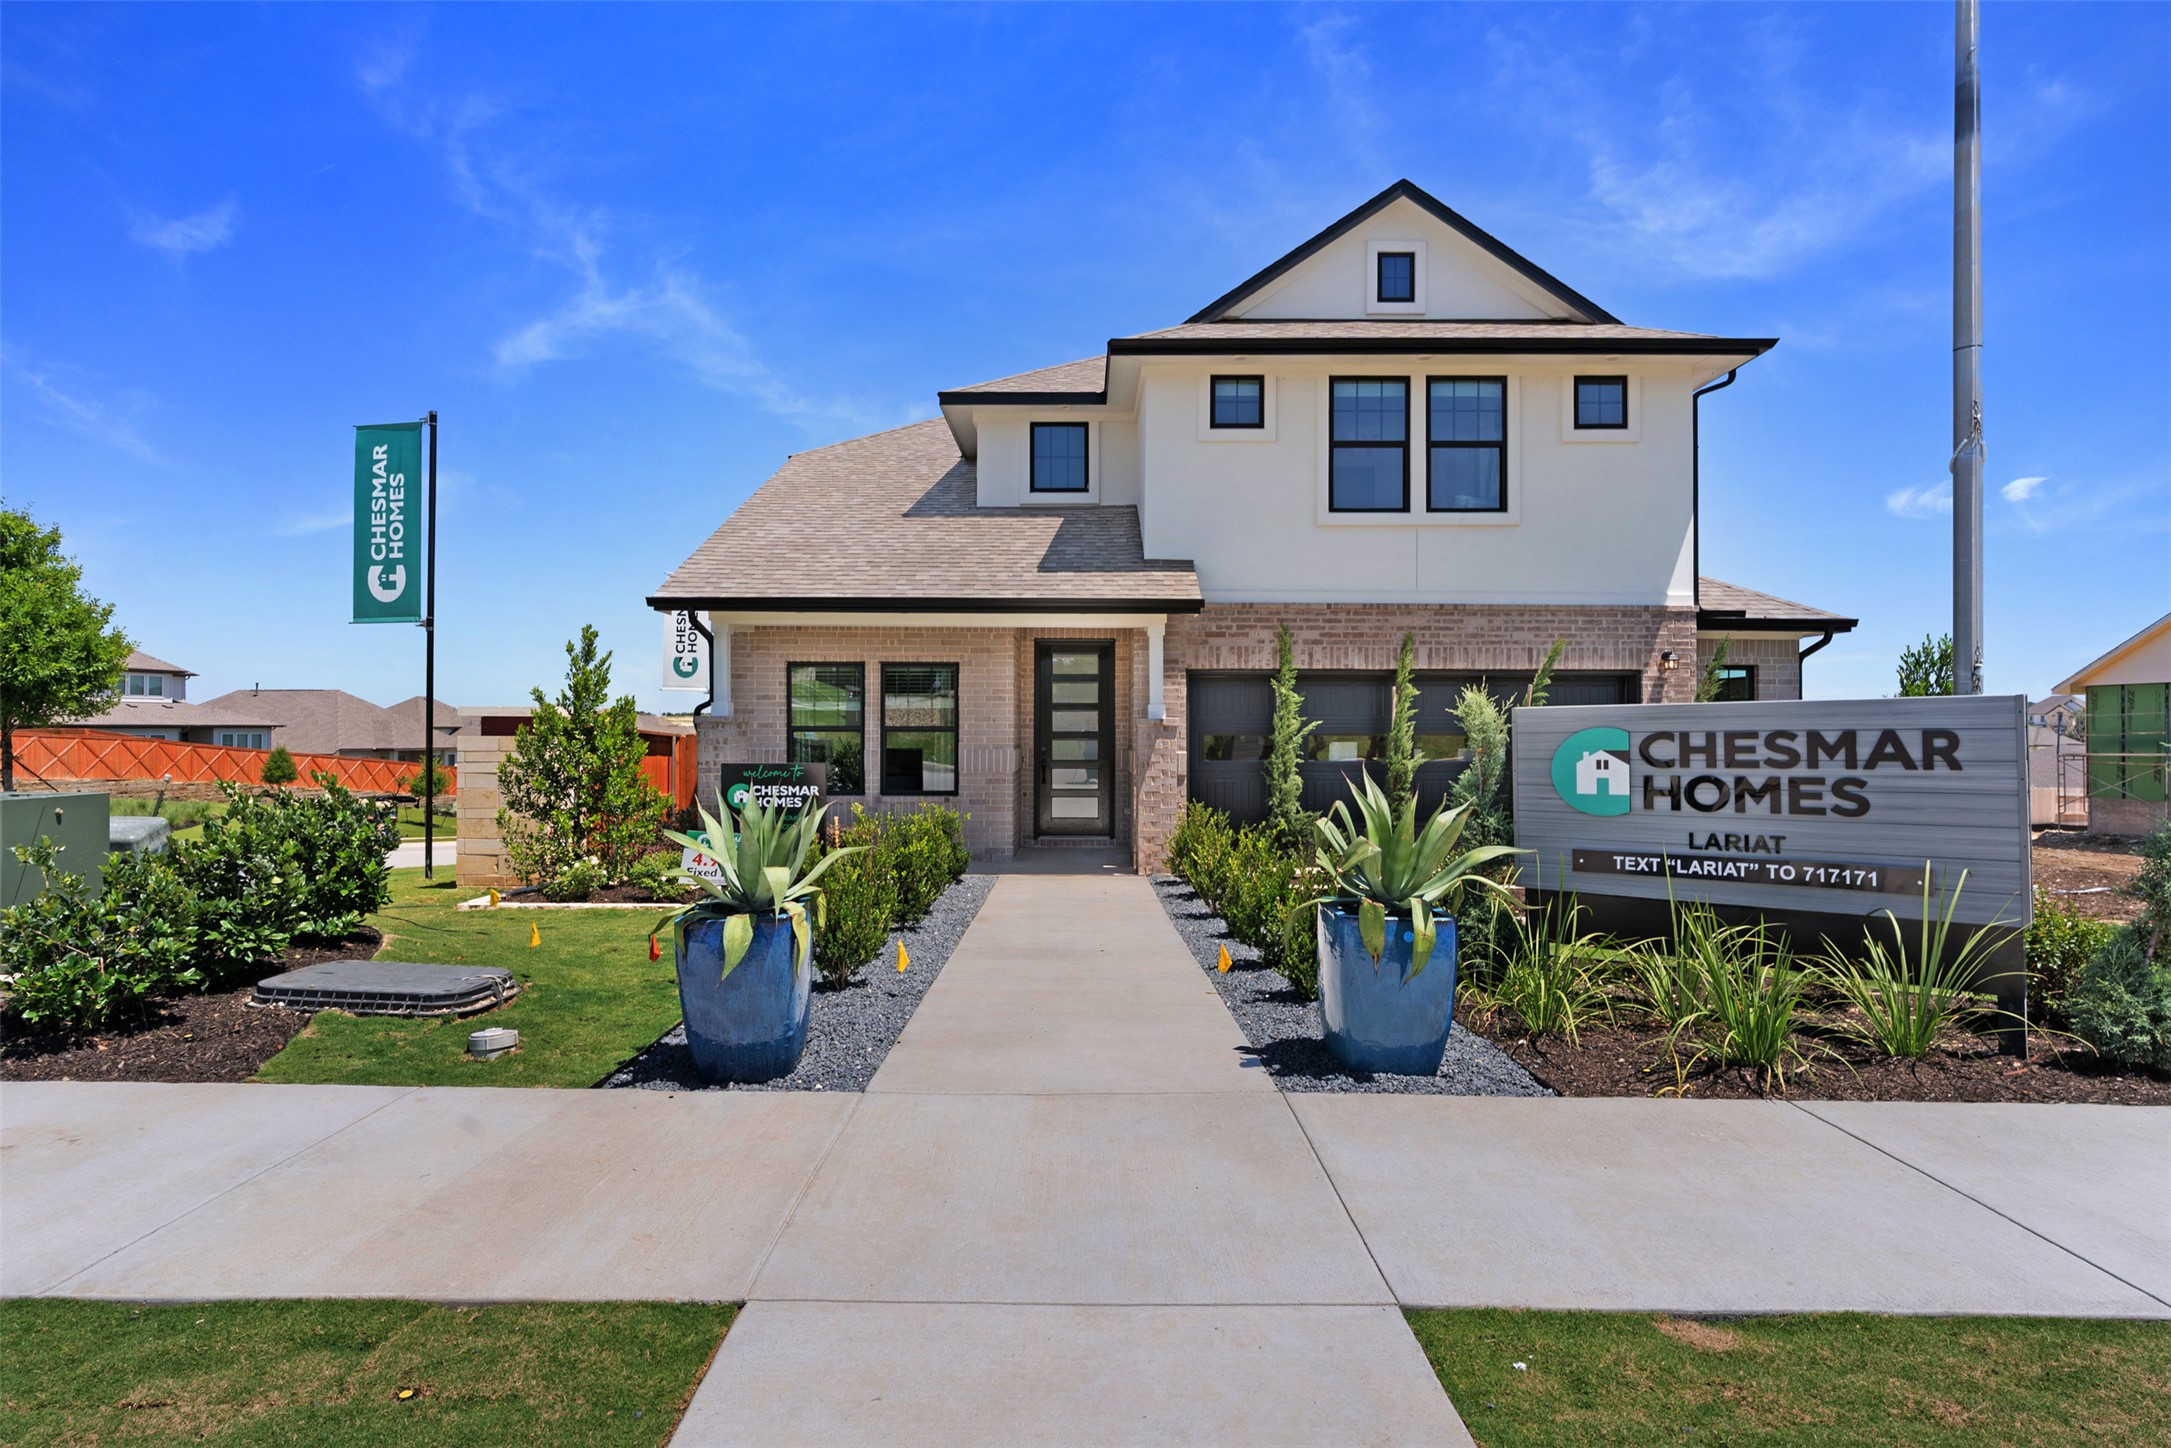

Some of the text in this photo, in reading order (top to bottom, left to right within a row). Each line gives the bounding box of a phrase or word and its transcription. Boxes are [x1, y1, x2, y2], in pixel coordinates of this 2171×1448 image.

[371, 444, 388, 561] CHESMAR
[388, 473, 405, 559] HOMES
[1639, 730, 1963, 771] CHESMAR
[743, 764, 804, 782] welcome to
[752, 785, 820, 796] CHESMAR
[1643, 775, 1871, 817] HOMES
[1689, 832, 1786, 854] LARIAT
[1613, 856, 1661, 872] TEXT
[1766, 864, 1796, 880] TO
[1803, 867, 1877, 887] 717171
